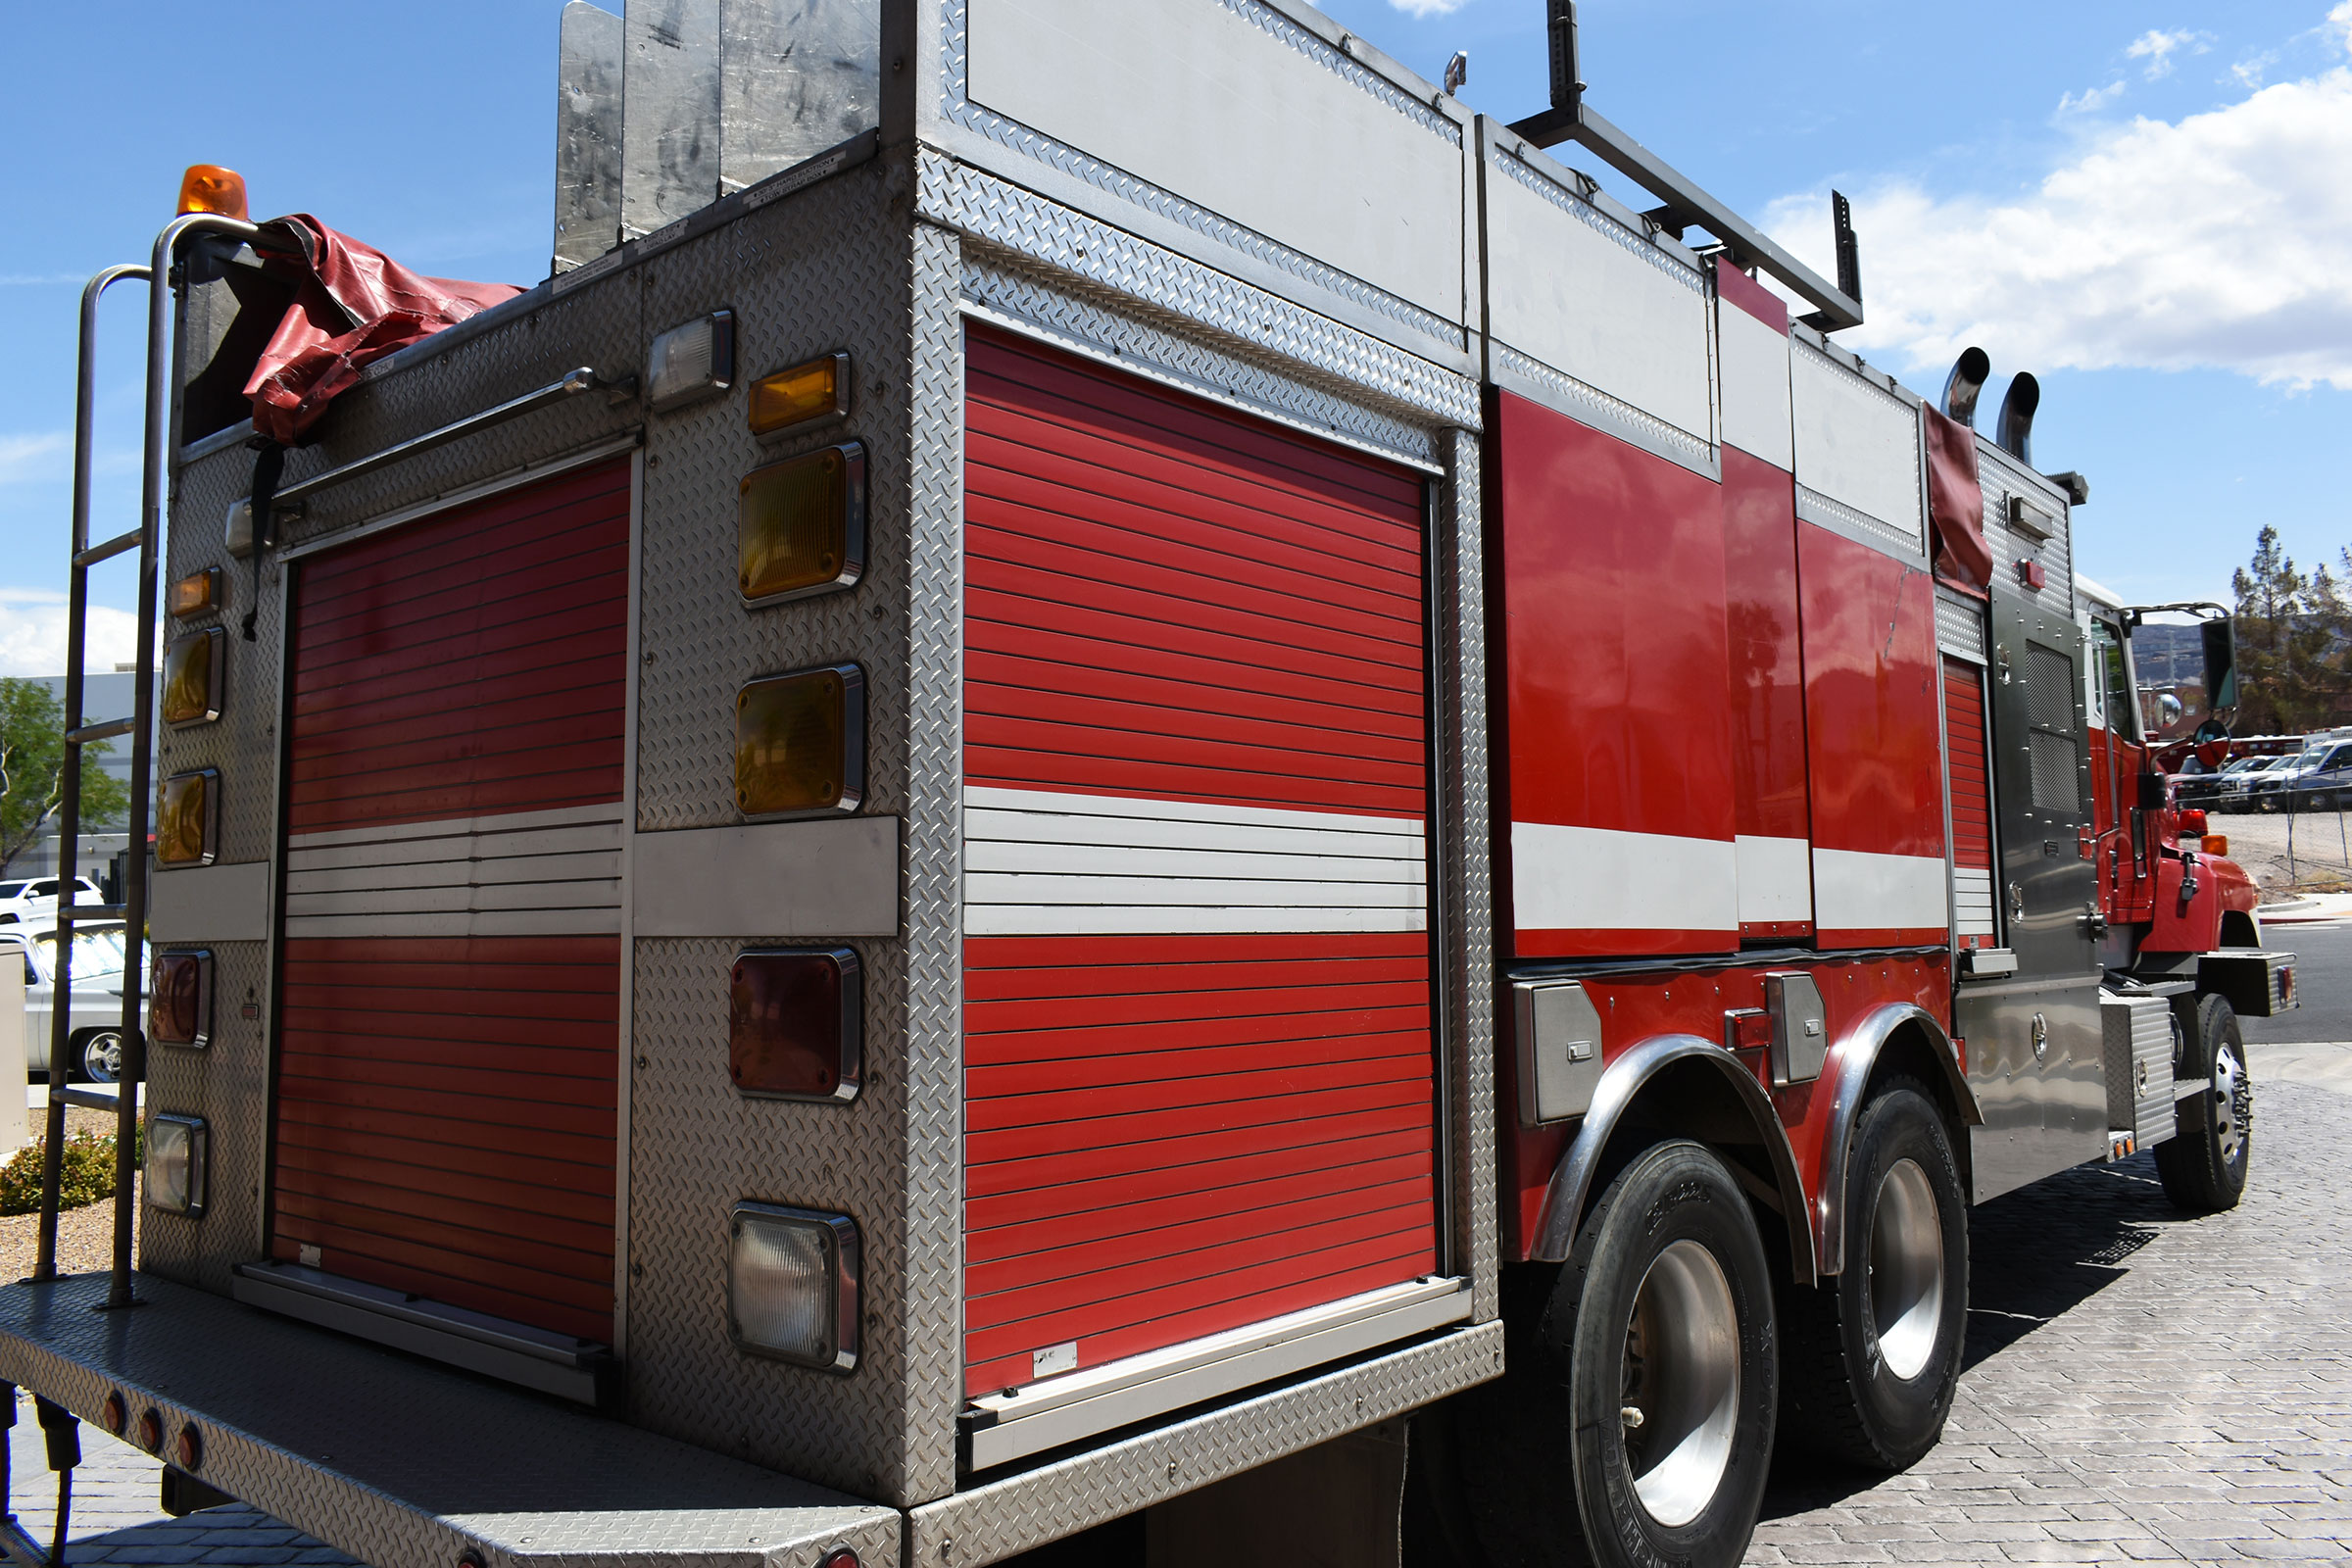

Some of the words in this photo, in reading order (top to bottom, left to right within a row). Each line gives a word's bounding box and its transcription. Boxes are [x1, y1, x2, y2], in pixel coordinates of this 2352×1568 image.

[764, 191, 781, 201] TOW
[807, 171, 822, 182] BOX
[776, 174, 797, 187] HARD
[798, 159, 830, 178] SUCTION
